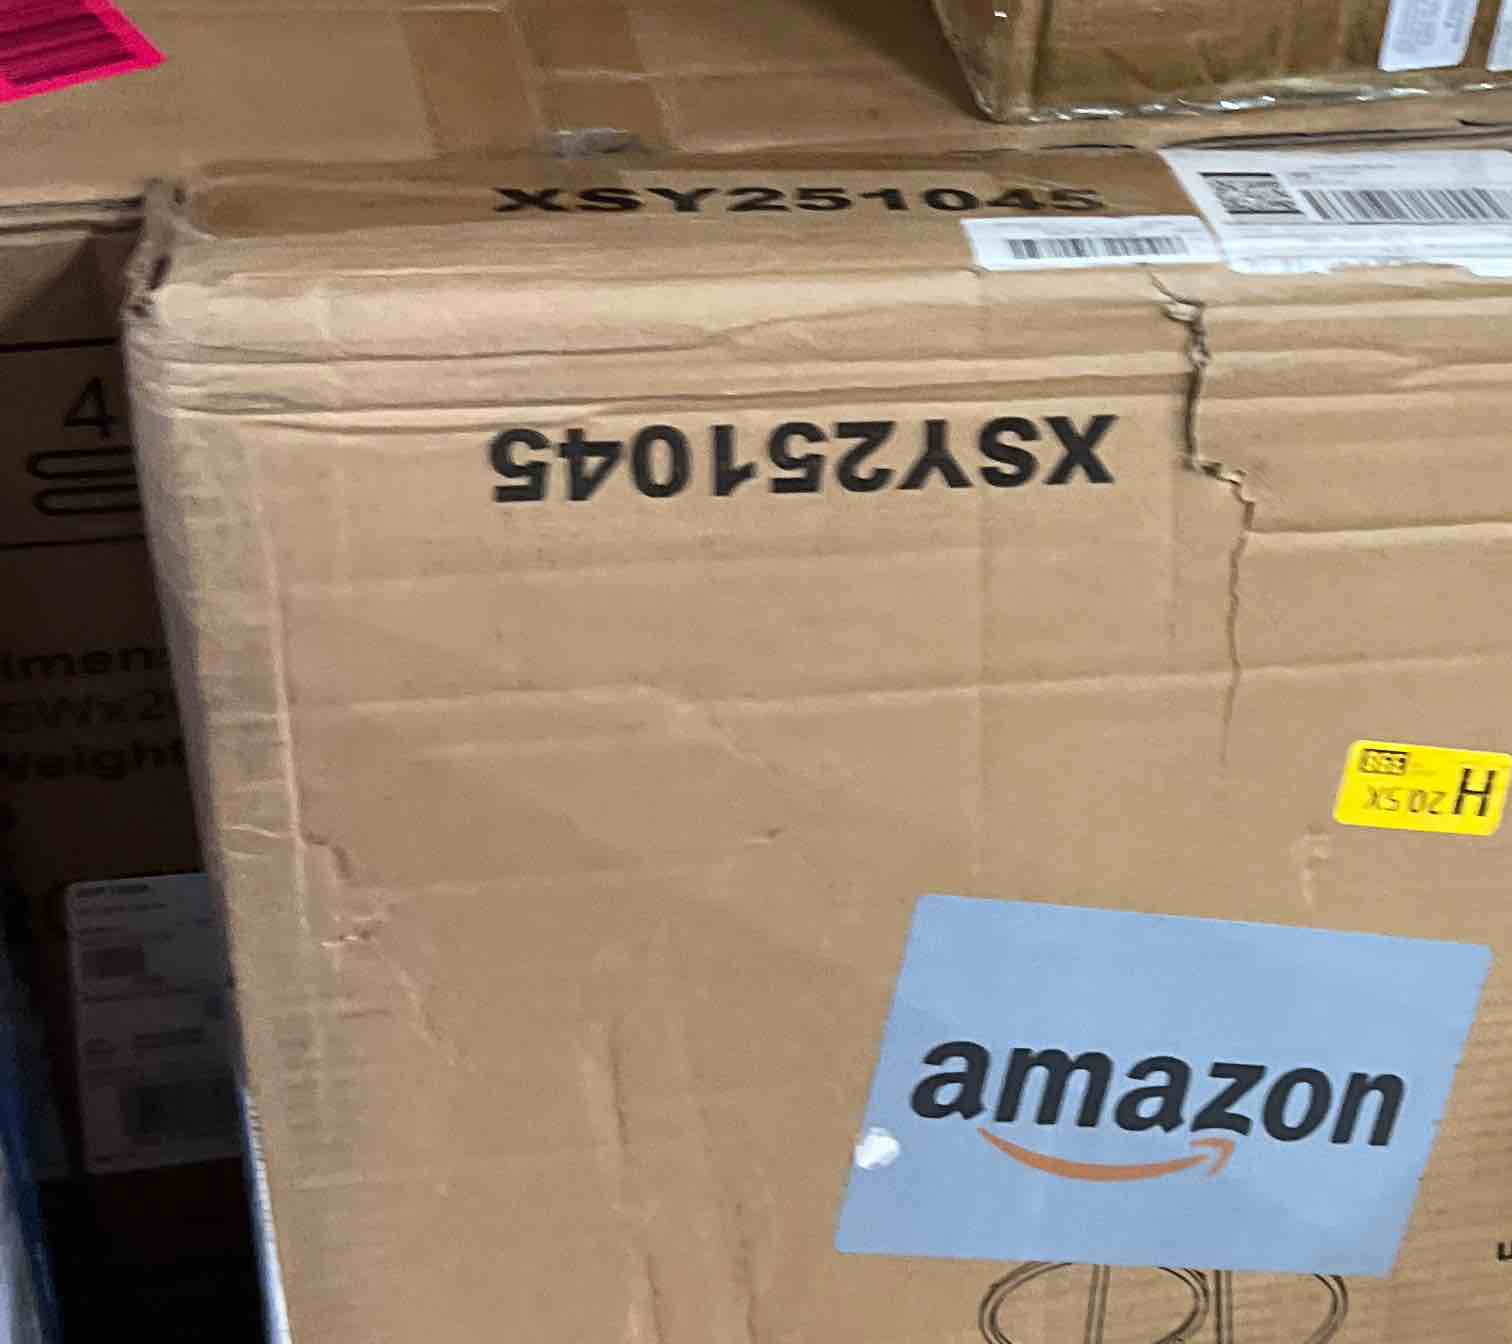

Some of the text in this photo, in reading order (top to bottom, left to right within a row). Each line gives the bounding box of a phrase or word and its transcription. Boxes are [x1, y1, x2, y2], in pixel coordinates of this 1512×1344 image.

[490, 185, 1105, 214] XSY251045
[488, 412, 1120, 504] XSY251045
[1452, 767, 1498, 817] H
[909, 1039, 1406, 1147] amazon
